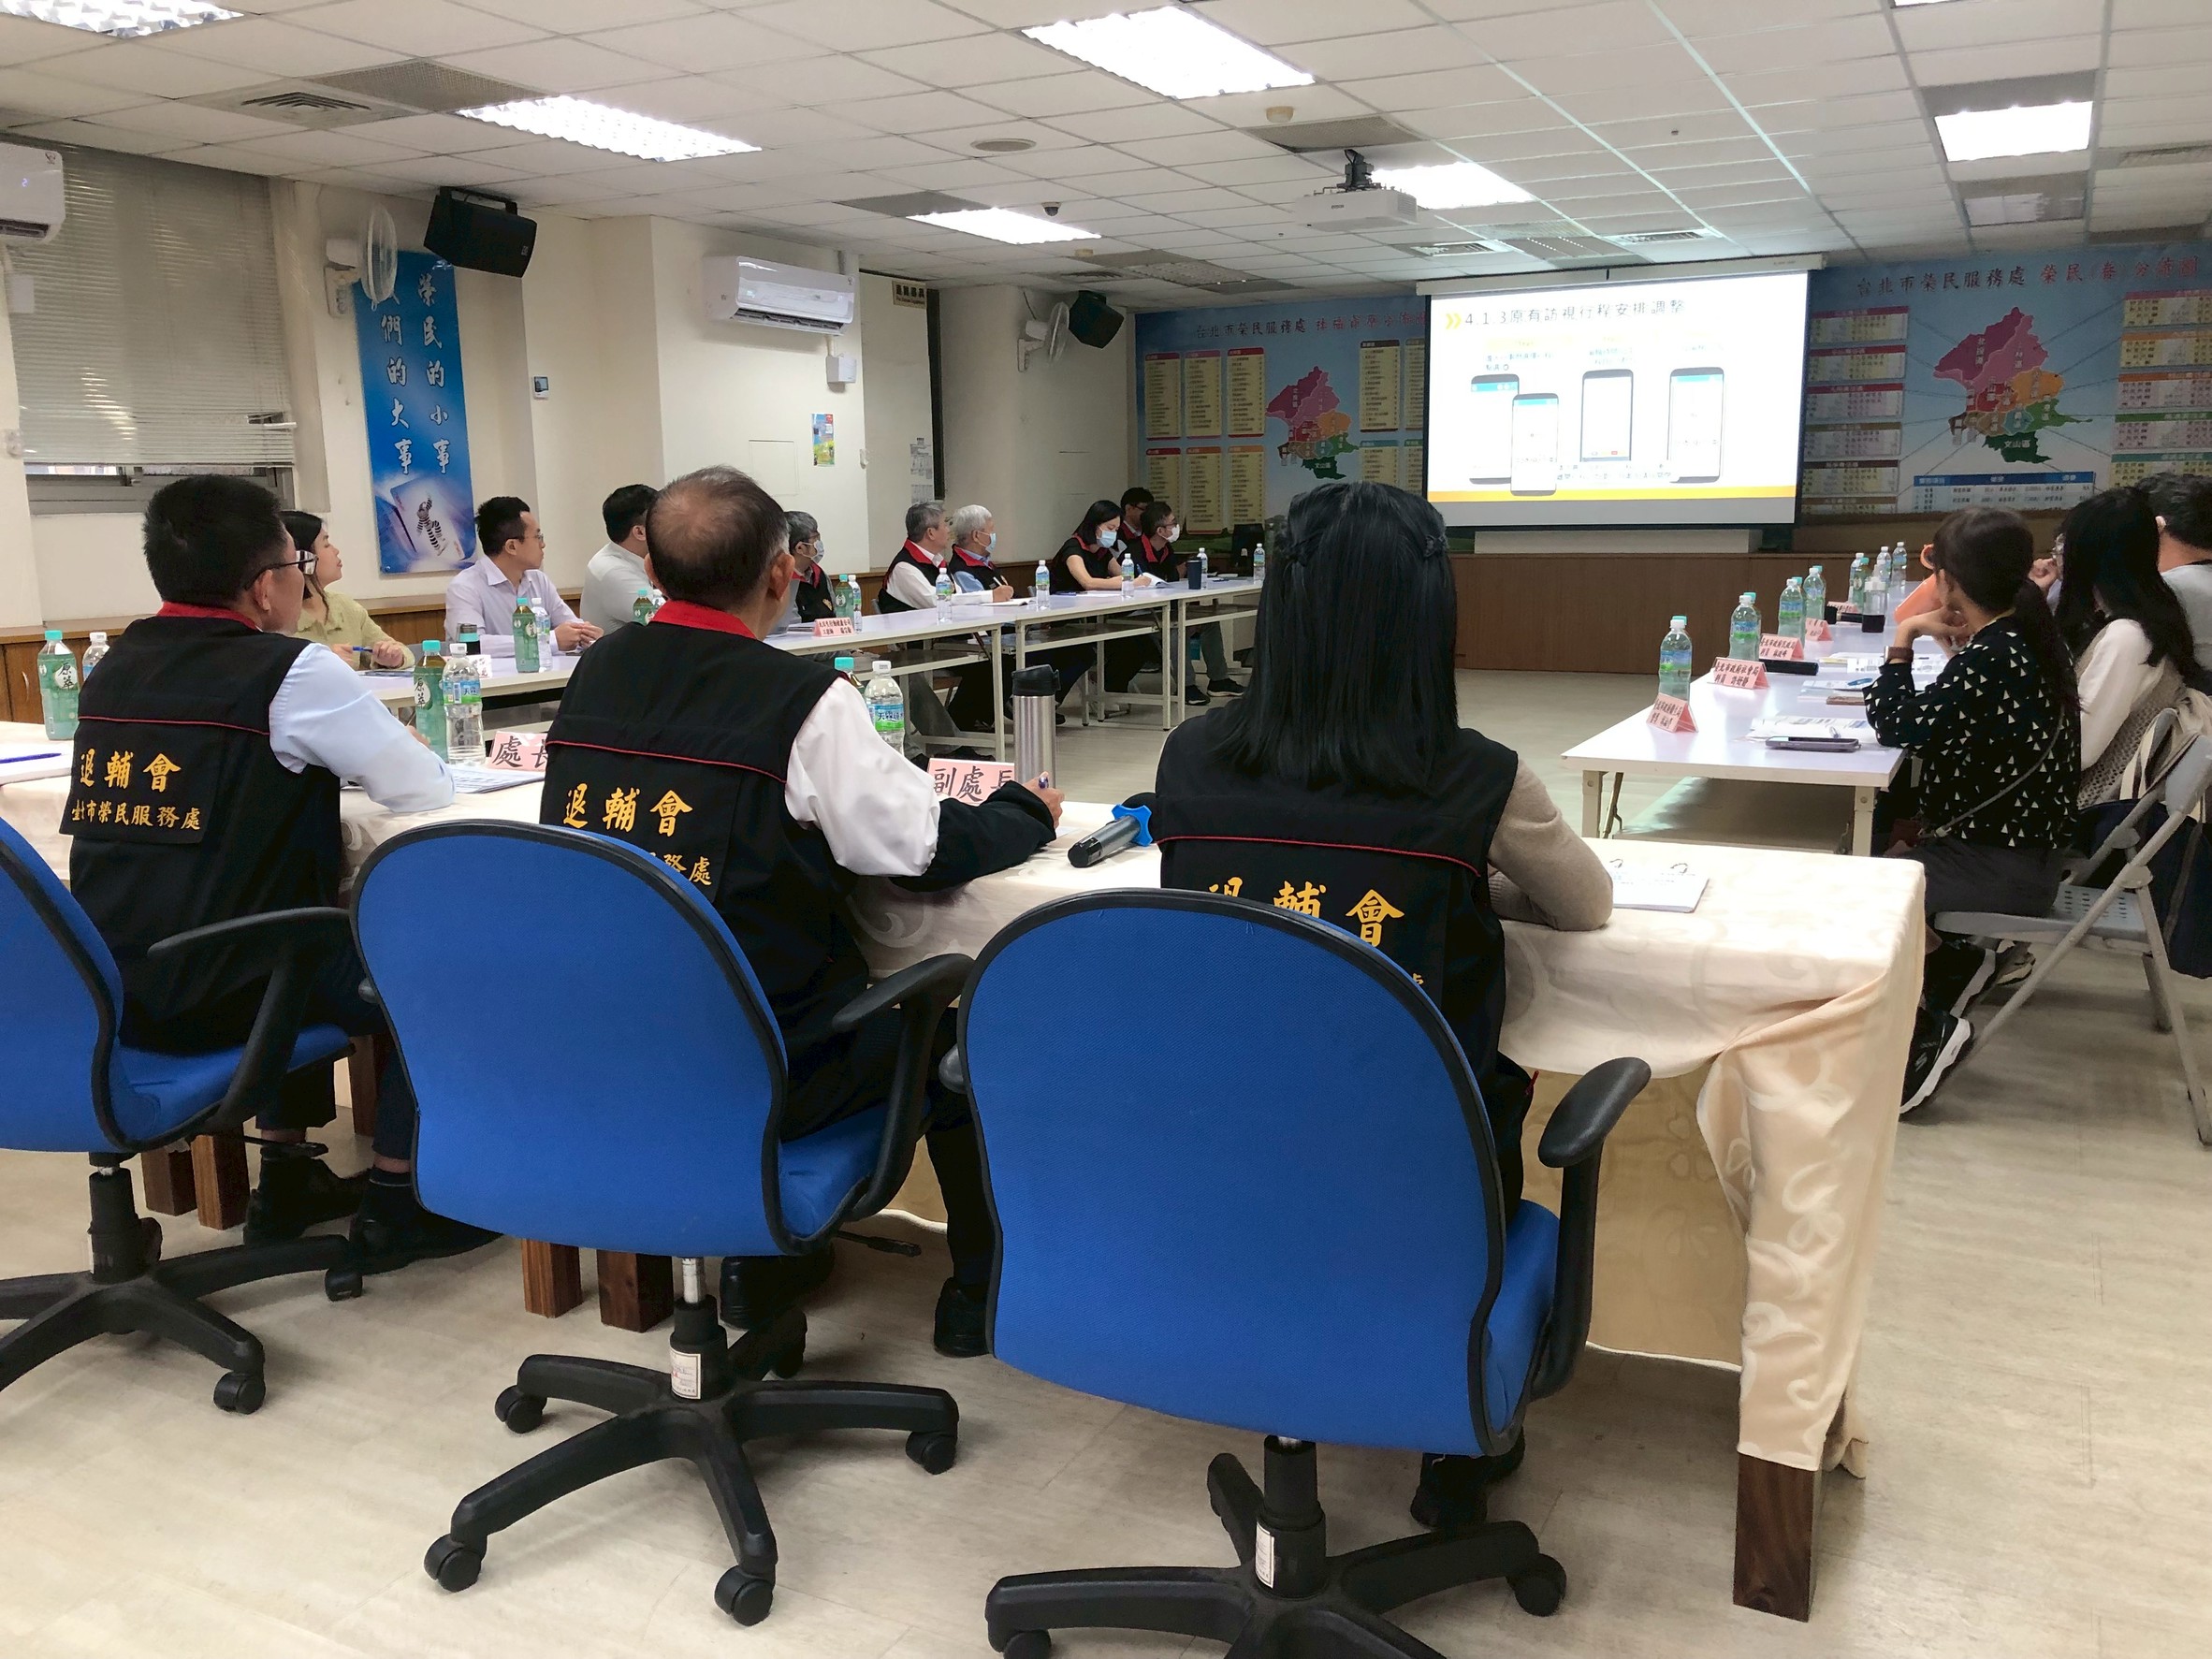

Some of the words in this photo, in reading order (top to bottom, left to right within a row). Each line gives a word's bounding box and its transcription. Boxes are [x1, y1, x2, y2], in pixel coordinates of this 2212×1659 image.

[1856, 266, 2026, 298] 台北市榮民服務處
[381, 289, 412, 474] 們的大事
[418, 272, 451, 474] 榮民的小事
[80, 748, 182, 793] 退輔會
[563, 782, 693, 837] 退輔會
[648, 851, 713, 886] 務處
